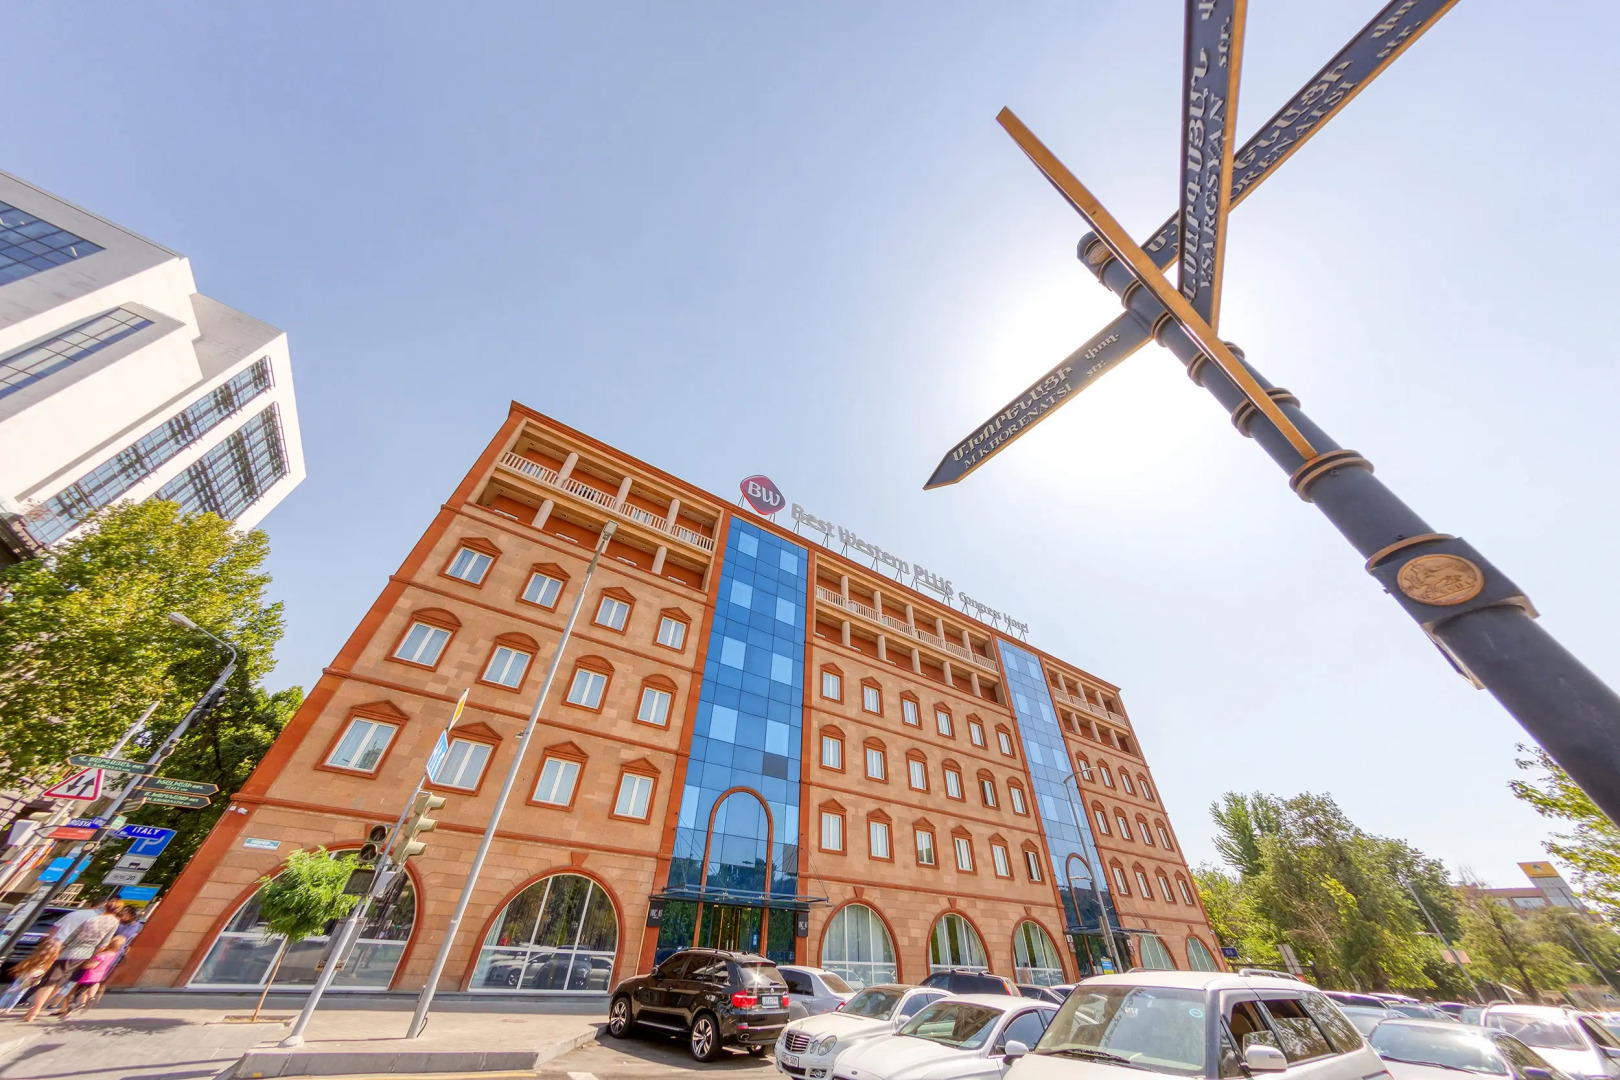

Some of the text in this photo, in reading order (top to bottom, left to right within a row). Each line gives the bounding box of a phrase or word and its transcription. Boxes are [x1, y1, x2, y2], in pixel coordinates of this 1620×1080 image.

[1219, 16, 1230, 67] str.
[1376, 21, 1422, 58] str.
[1084, 333, 1120, 361] փող.
[1086, 359, 1108, 378] str.
[748, 480, 780, 507] BW
[791, 502, 835, 538] Best
[837, 525, 910, 575] Western
[958, 591, 1002, 620] Congress
[1003, 612, 1030, 634] Hotel
[131, 826, 161, 836] ITALY
